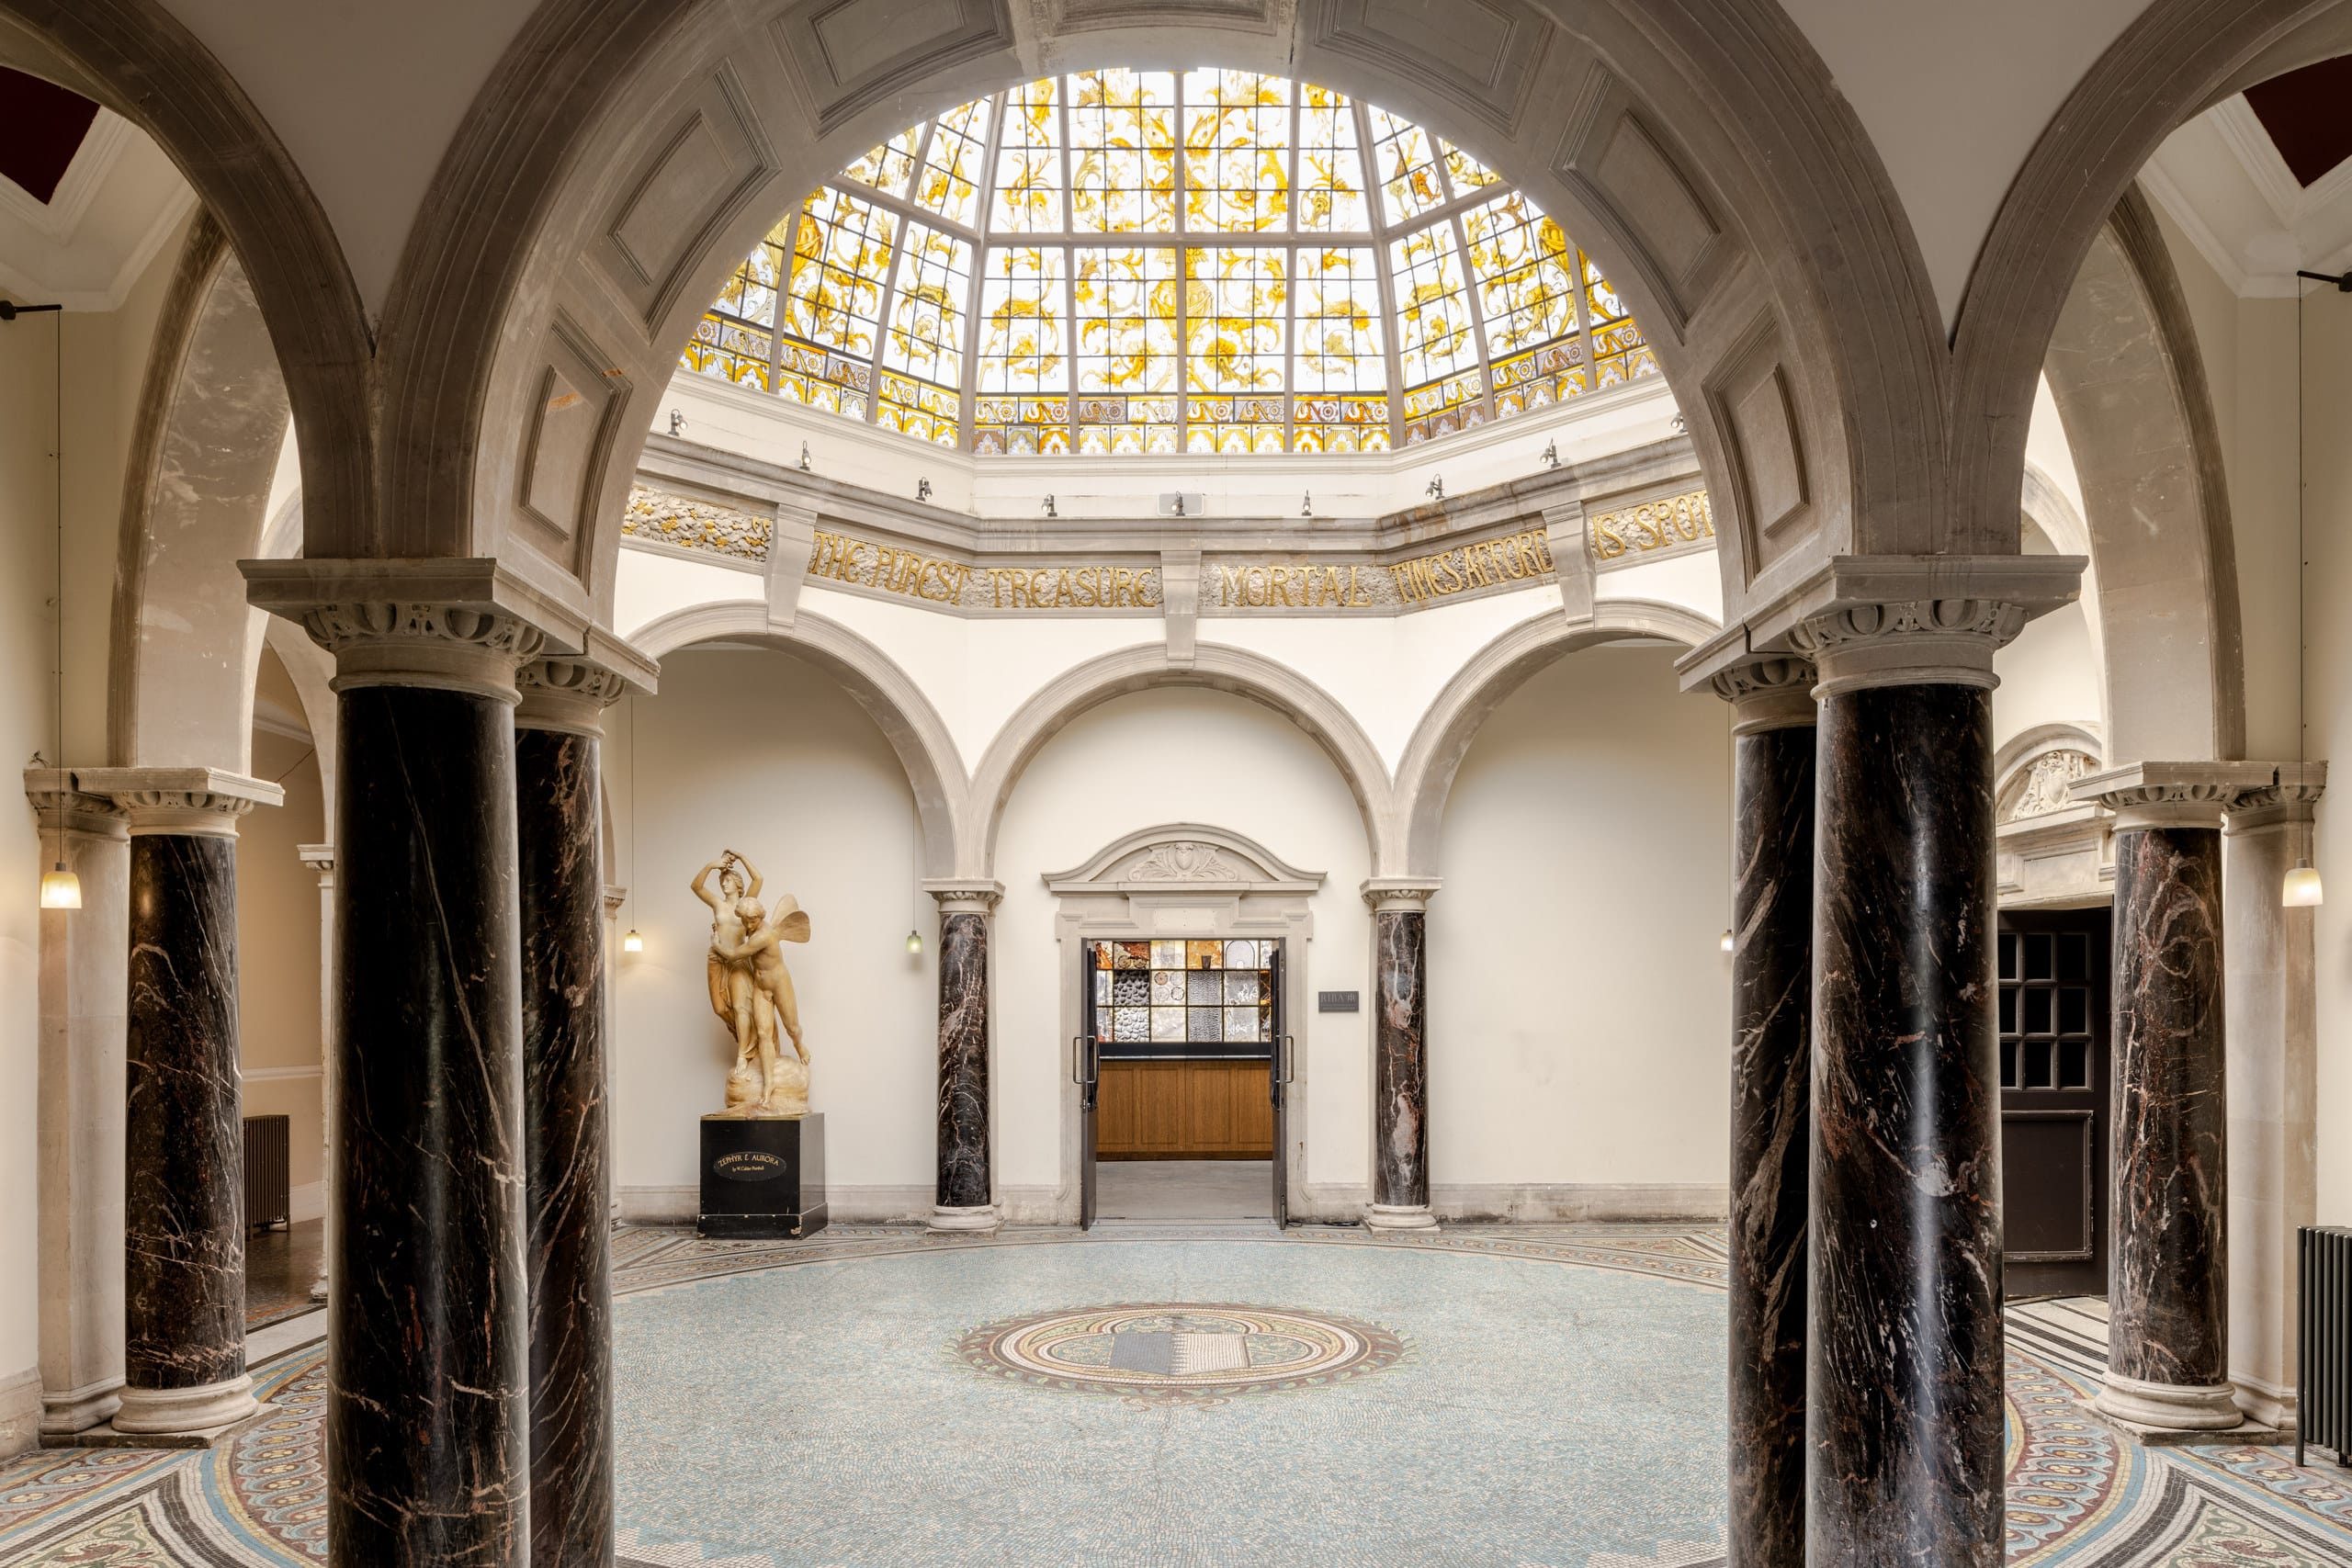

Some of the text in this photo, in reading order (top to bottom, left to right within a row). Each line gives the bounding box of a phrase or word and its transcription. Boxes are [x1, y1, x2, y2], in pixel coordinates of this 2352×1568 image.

[808, 533, 865, 582] THE
[869, 547, 971, 605] PUREST
[986, 567, 1156, 607] TREASURE
[1221, 566, 1372, 606] MORTAL
[1389, 550, 1463, 604] TIMES
[1464, 530, 1555, 589] AFFORD
[1592, 513, 1625, 559] IS
[718, 1155, 742, 1167] ZEPHYR
[752, 1154, 779, 1166] AURORA
